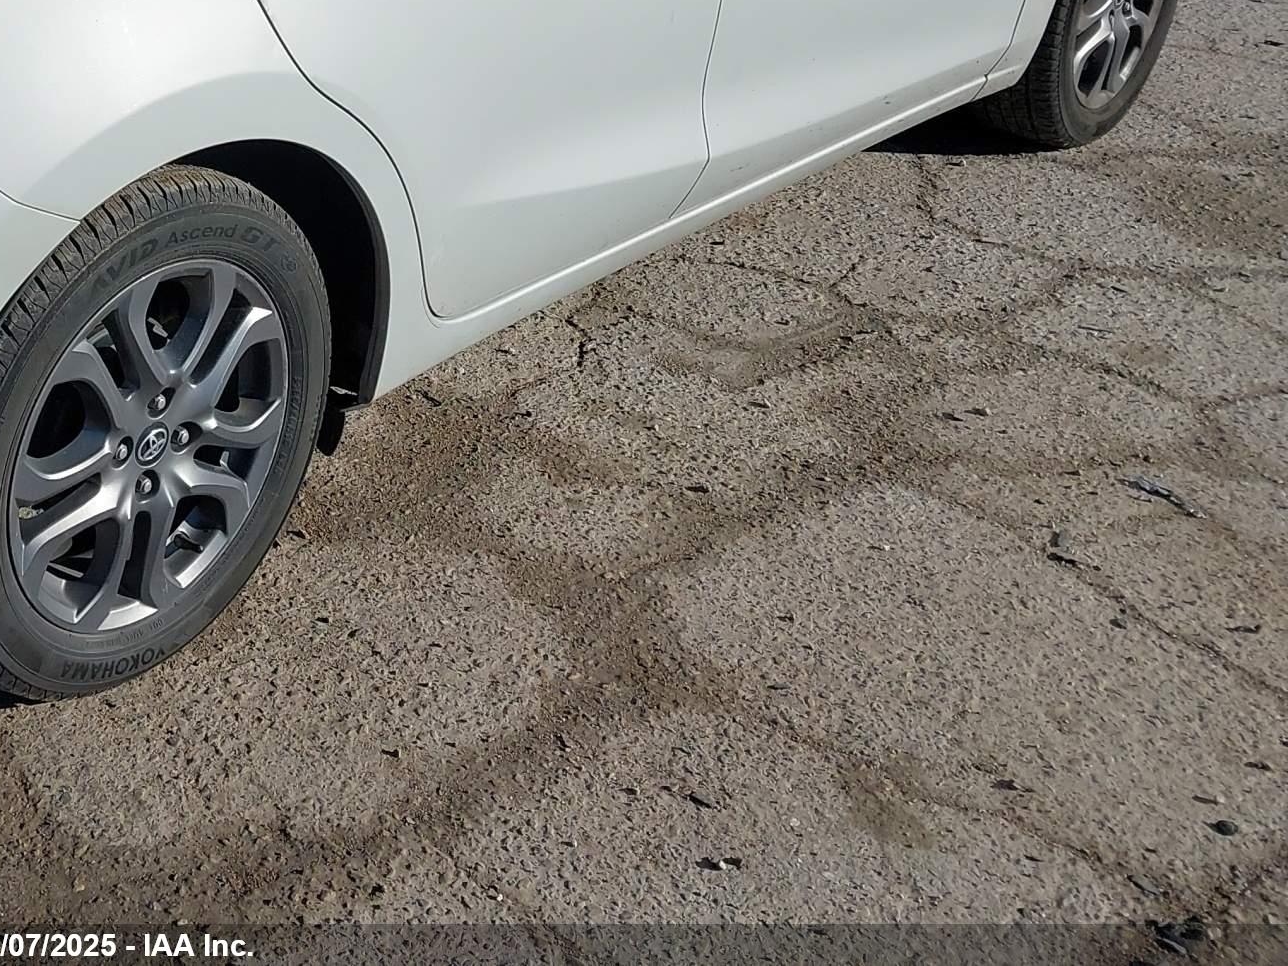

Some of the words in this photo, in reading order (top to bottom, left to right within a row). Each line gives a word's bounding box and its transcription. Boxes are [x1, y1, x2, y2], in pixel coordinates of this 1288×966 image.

[165, 224, 239, 248] Ascend
[240, 225, 282, 252] GT
[62, 647, 166, 679] YOKOHAMA
